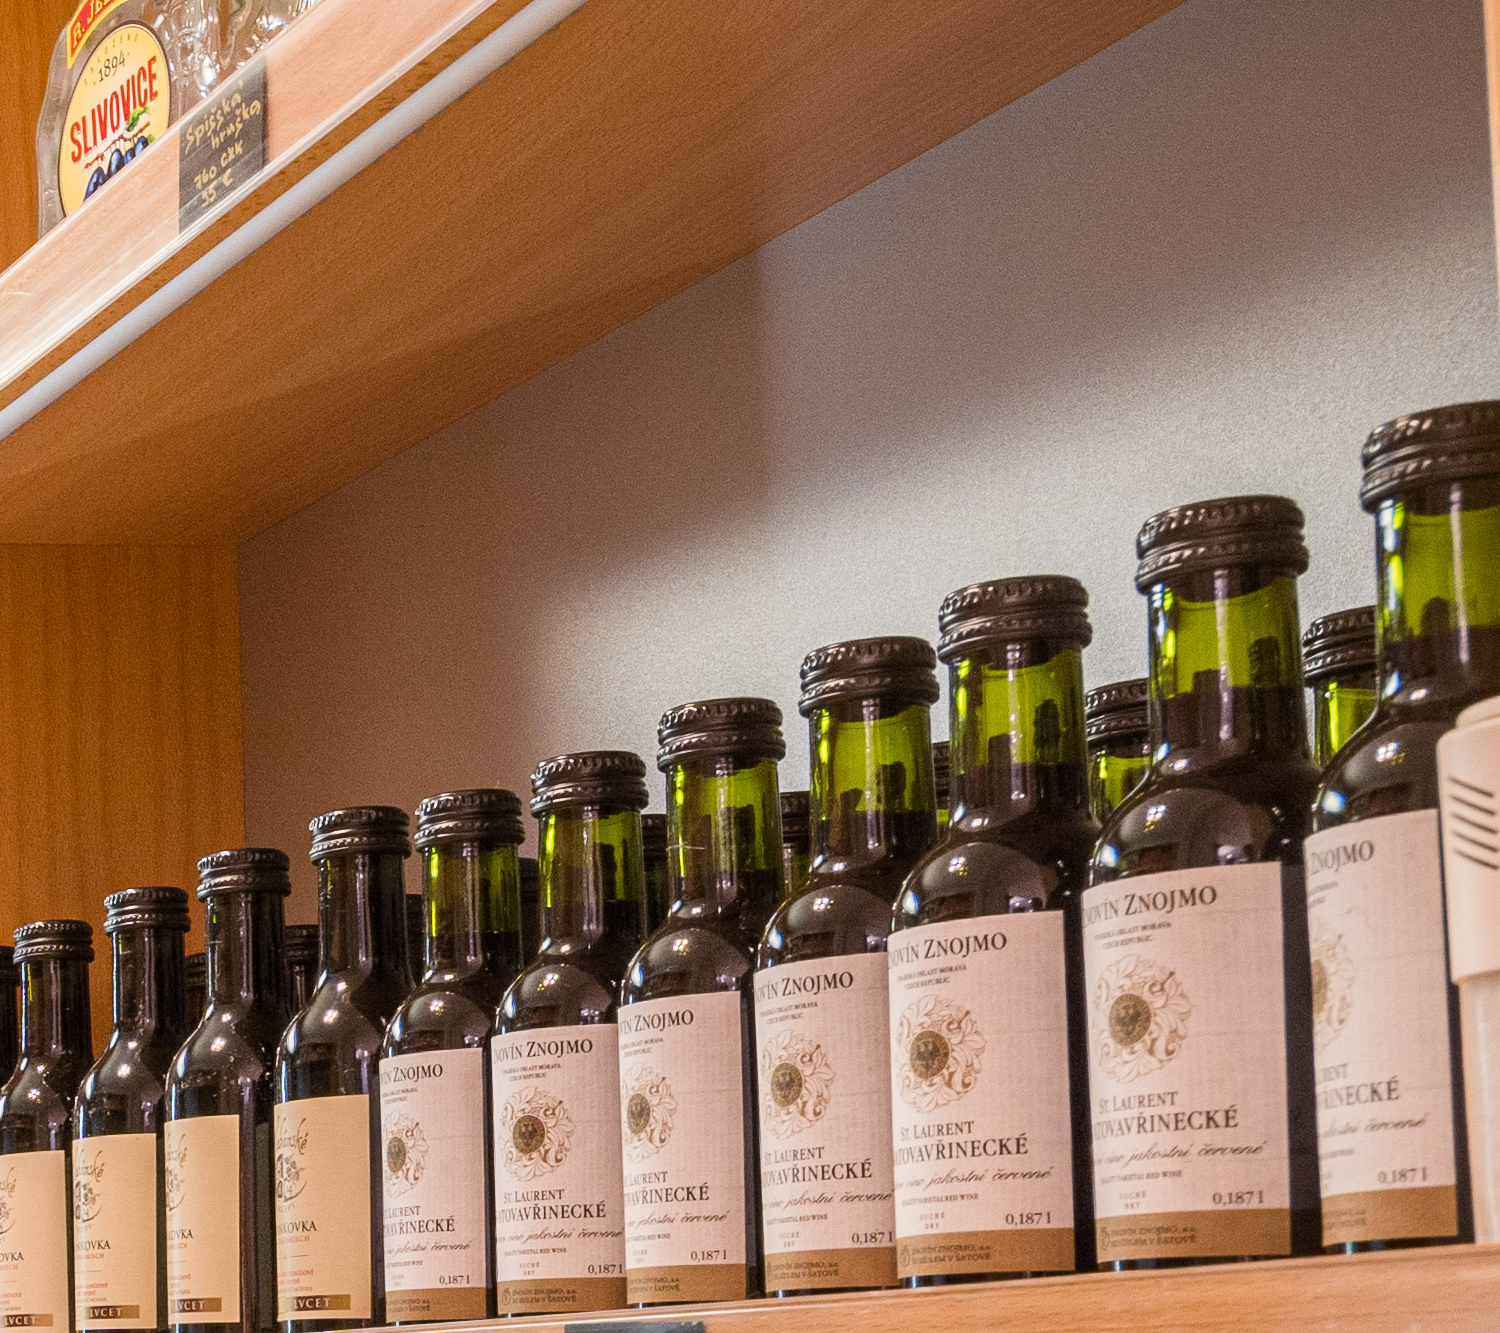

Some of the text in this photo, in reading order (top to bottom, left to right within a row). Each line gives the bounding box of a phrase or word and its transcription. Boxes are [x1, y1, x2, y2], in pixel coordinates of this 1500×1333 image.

[98, 51, 126, 83] 1894
[70, 55, 158, 163] SLIVOVICE
[1124, 885, 1217, 917] ZNOJMO
[924, 931, 1008, 959] ZNOJMO
[526, 1038, 593, 1059] ZNOJMO
[1112, 1091, 1178, 1113] LAURENT
[913, 1121, 975, 1140] LAURENT
[1005, 1211, 1043, 1227] 0,187
